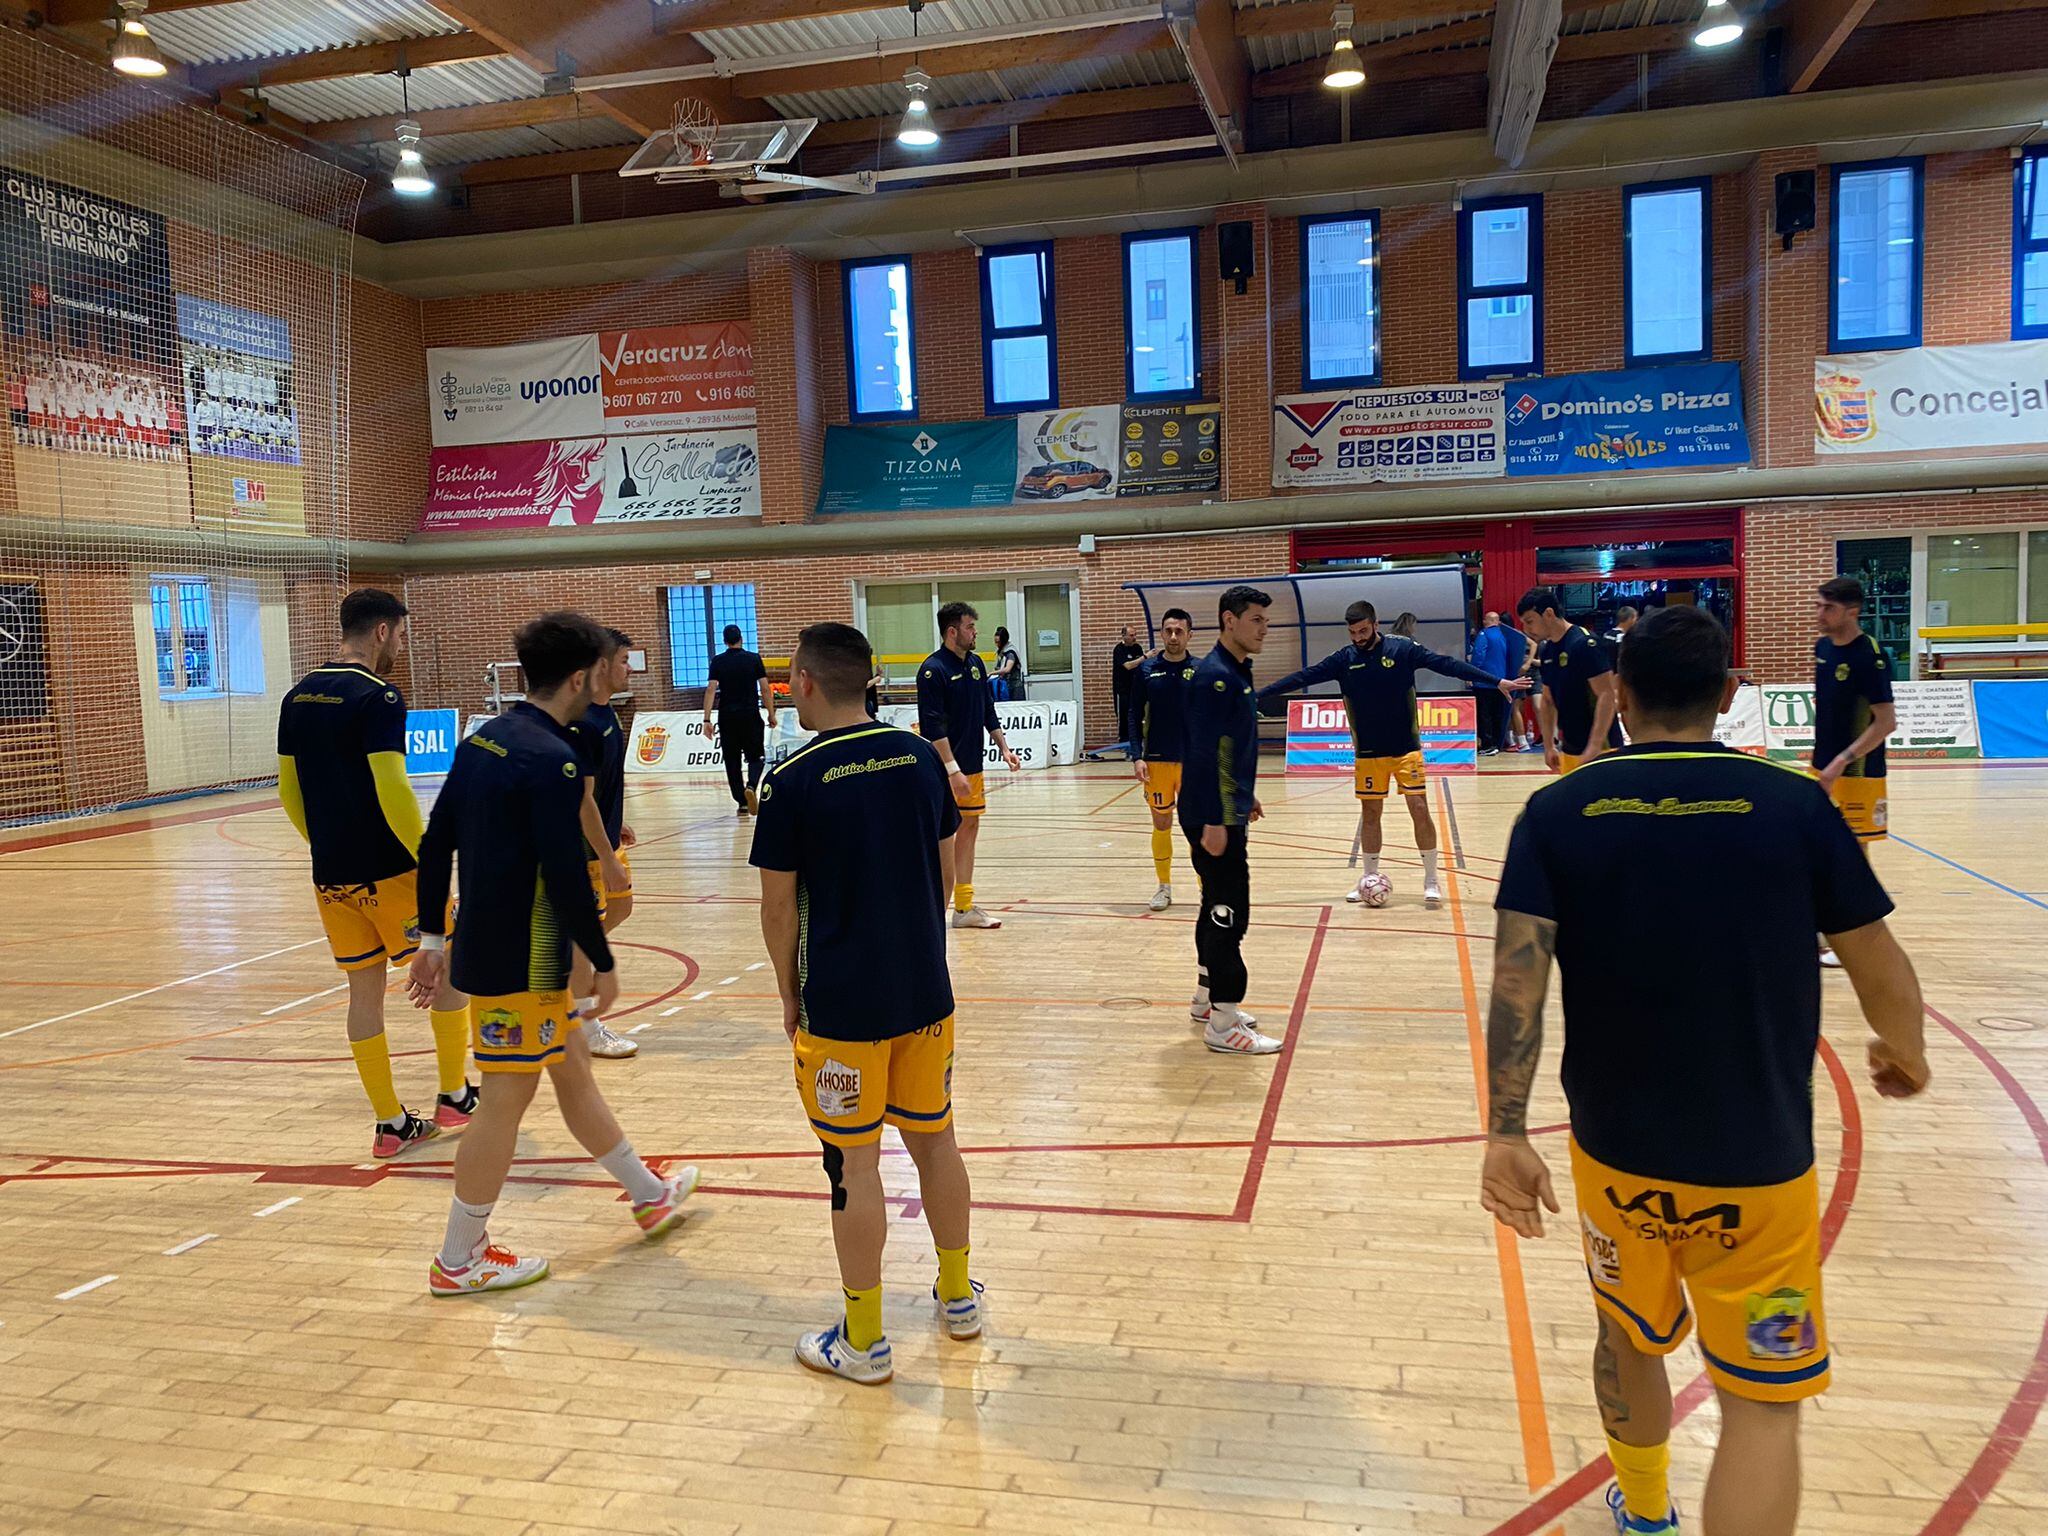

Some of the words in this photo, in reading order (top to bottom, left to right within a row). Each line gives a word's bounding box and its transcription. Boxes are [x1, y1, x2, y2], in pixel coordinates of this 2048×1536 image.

[7, 180, 56, 207] CLUB
[61, 195, 150, 236] MÓSTOLES
[40, 225, 128, 264] FEMENINO
[97, 224, 139, 250] SALA
[53, 294, 105, 314] Comunidad
[107, 308, 118, 317] de
[120, 310, 149, 325] Madrid
[600, 333, 708, 376] Veracruz
[615, 377, 644, 386] CENTRO
[703, 371, 714, 380] DE
[520, 375, 600, 403] uponor
[709, 386, 732, 401] 916
[612, 393, 633, 408] 607
[636, 391, 657, 406] 067
[661, 389, 682, 405] 270
[1356, 393, 1434, 408] REPUESTOS
[1437, 390, 1466, 402] SUR
[1541, 393, 1654, 420] Domino's
[1661, 390, 1730, 411] Pizza
[1130, 407, 1182, 417] CLEMENTE
[1340, 413, 1371, 422] TODO
[1376, 411, 1404, 419] PARA
[1426, 405, 1495, 416] AUTOMÓVIL
[1344, 420, 1489, 435] www.repuestos-sur.com
[1728, 421, 1739, 431] 24
[1033, 434, 1090, 445] CLEMEN
[1558, 431, 1565, 441] 9
[663, 437, 716, 453] Jardinería
[1574, 439, 1667, 459] MOSOLES
[1678, 445, 1695, 453] 916
[885, 457, 962, 474] TIZONA
[1294, 455, 1316, 463] SUR
[1510, 455, 1526, 464] 916
[1527, 454, 1542, 462] 141
[1544, 453, 1560, 462] 727
[436, 464, 498, 483] Estilistas
[433, 487, 472, 502] Mónica
[474, 482, 533, 500] Granados
[699, 484, 753, 496] Limpiezas
[425, 502, 553, 521] www.monicagranados.es
[1365, 776, 1373, 789] 5
[1152, 792, 1163, 804] 11
[816, 1070, 859, 1092] AHOSBE
